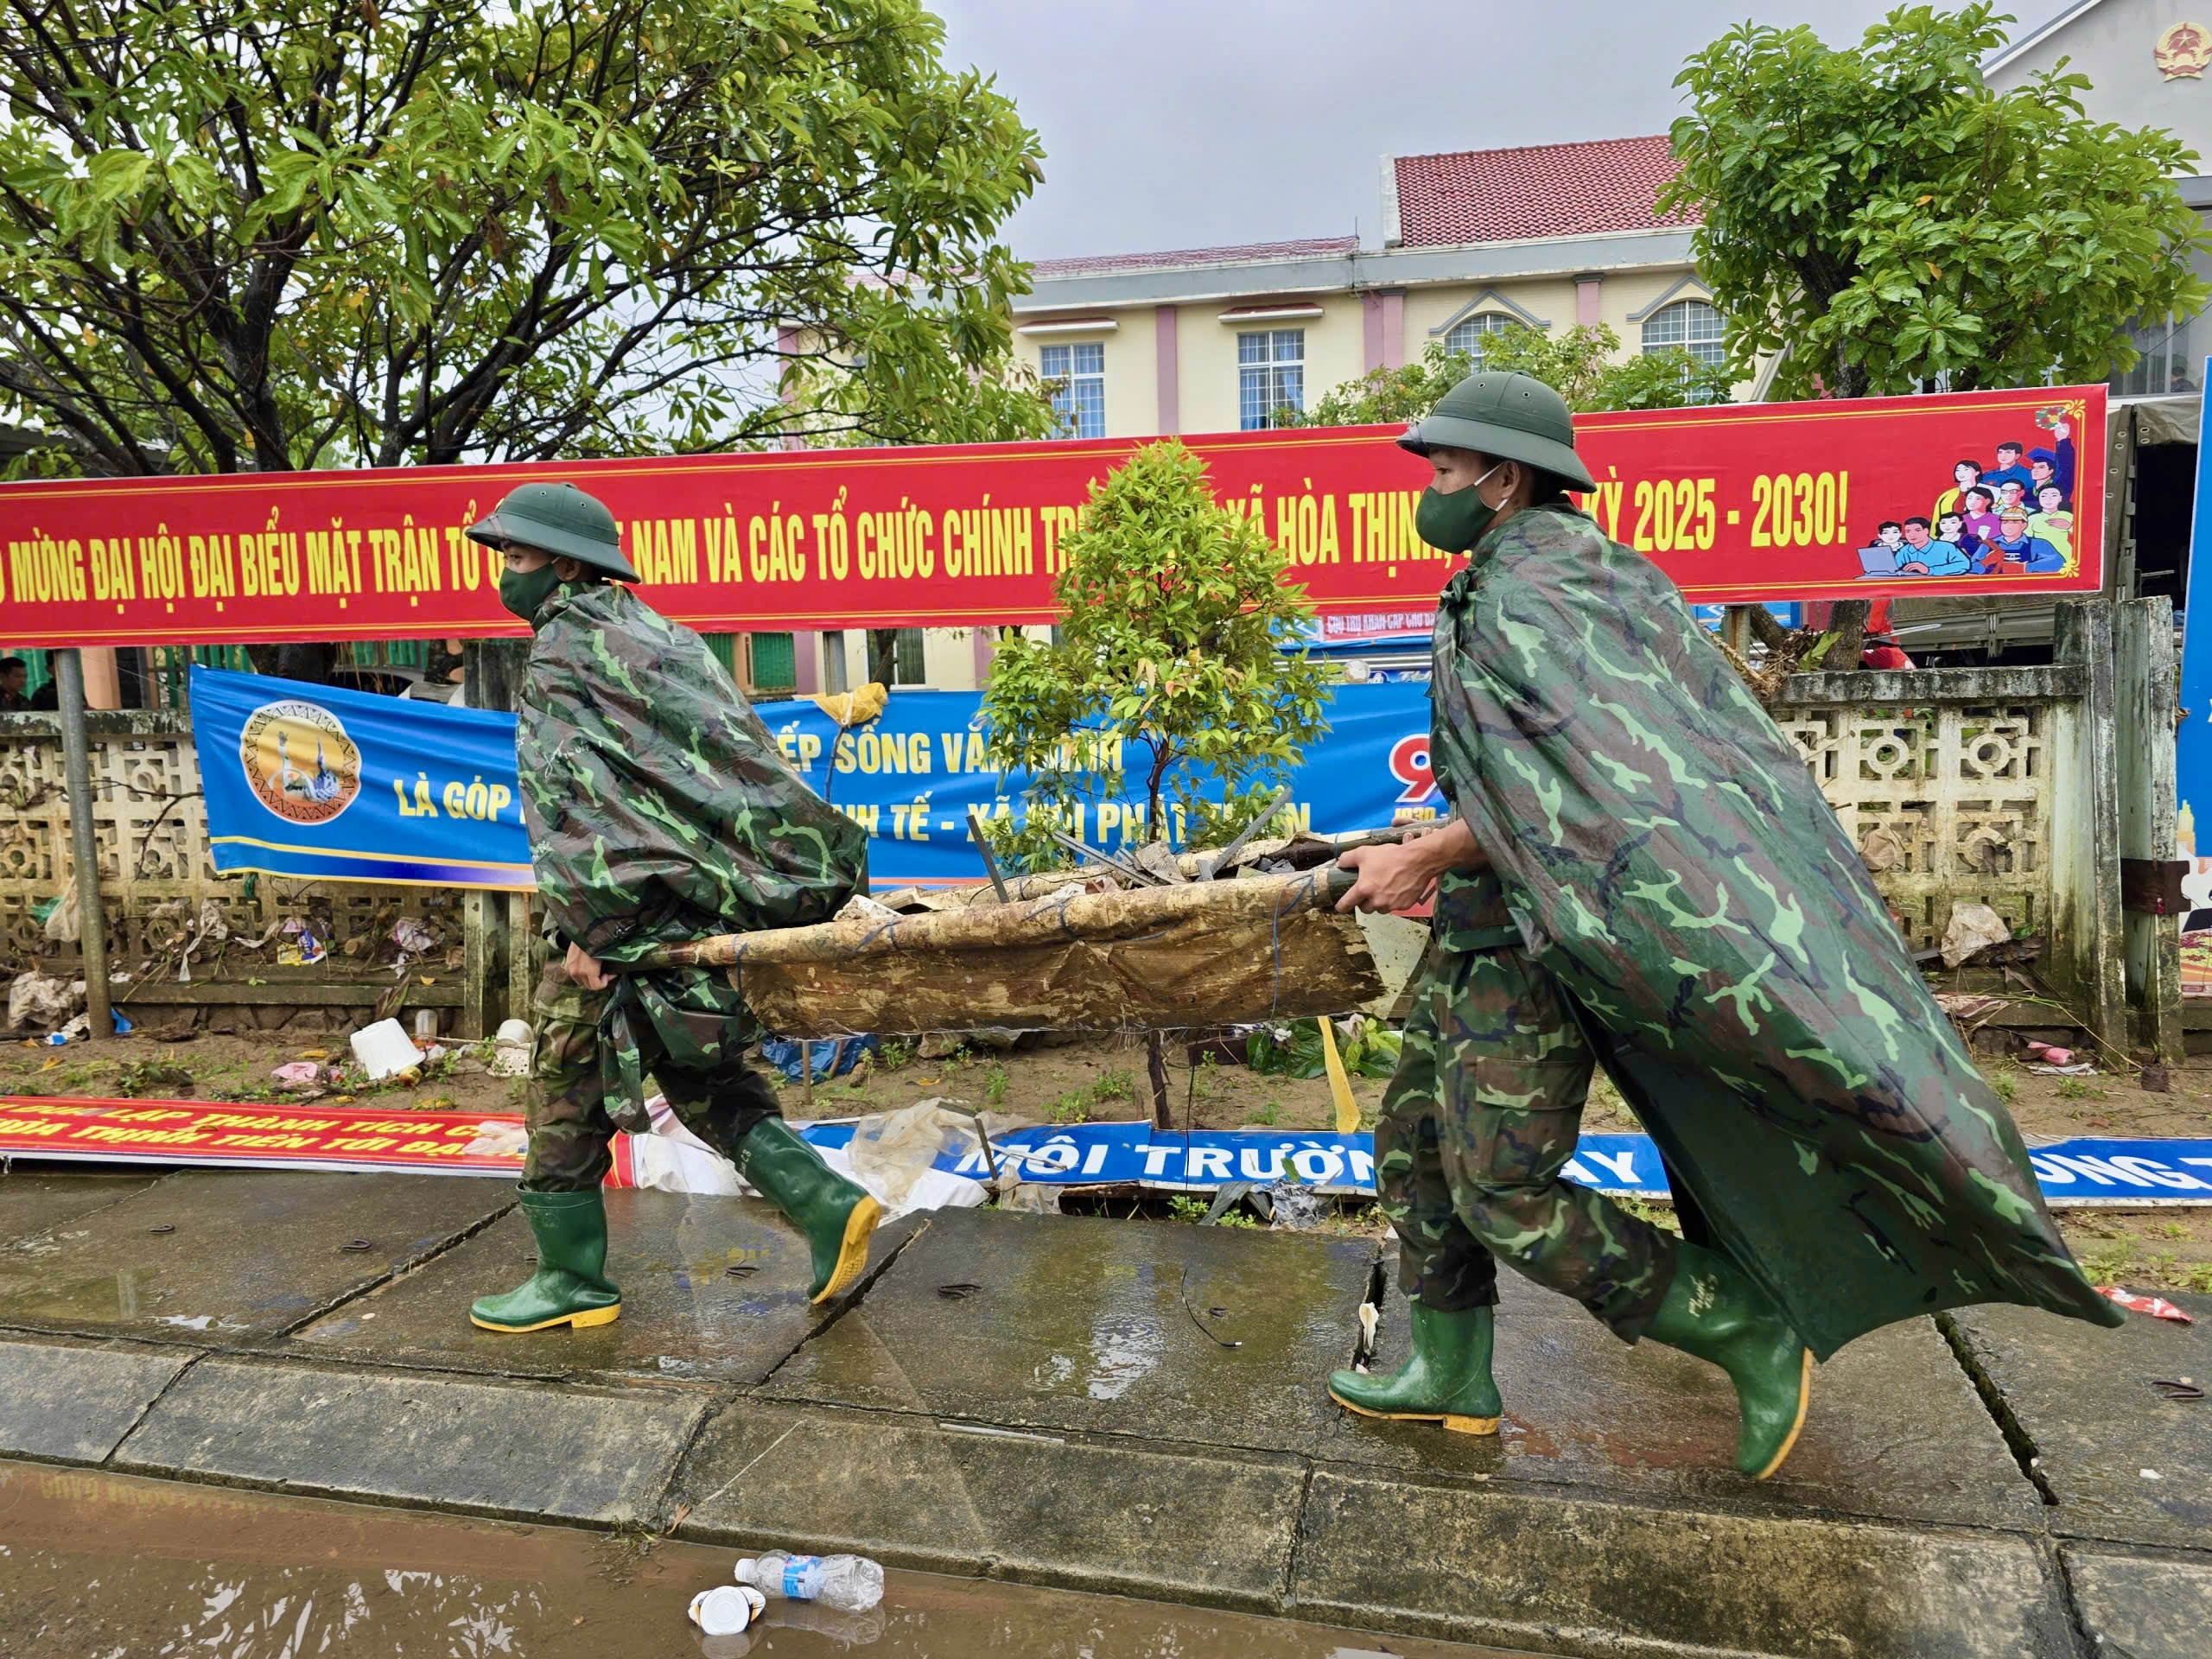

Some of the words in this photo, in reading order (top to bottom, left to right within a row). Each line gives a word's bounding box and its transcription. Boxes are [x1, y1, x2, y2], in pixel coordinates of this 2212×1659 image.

[9, 526, 87, 603] MỪNG
[89, 537, 136, 614] ĐẠI
[138, 522, 186, 613] HỘI
[188, 535, 236, 613] ĐẠI
[239, 506, 299, 596] BIỂU
[306, 517, 362, 609] MẶT
[367, 514, 442, 607] TRẬN
[445, 498, 480, 592] TỔ
[632, 518, 698, 585] NAM
[704, 502, 742, 583] VÀ
[749, 500, 805, 583] CÁC
[813, 485, 849, 582] TỔ
[857, 496, 935, 580] CHỨC
[943, 493, 1033, 578] CHÍNH
[1277, 477, 1340, 566] HÒA
[1349, 490, 1452, 578] THỊN,
[1632, 478, 1716, 553] 2025
[1727, 510, 1740, 524] -
[1751, 470, 1849, 548] 2030!
[777, 720, 822, 772] ẾP
[833, 718, 931, 775] SỐNG
[393, 772, 438, 817] LÀ
[443, 774, 512, 823] GÓP
[890, 790, 931, 841] TẾ
[940, 821, 955, 830] -
[68, 1125, 214, 1145] THỊNH
[320, 1136, 399, 1152] TỚI
[397, 1141, 467, 1156] ĐẠ
[191, 1114, 343, 1132] THÀNH
[343, 1120, 444, 1136] TÍCH
[954, 1135, 1109, 1175] MÔI
[1135, 1140, 1374, 1180] TRƯỜN
